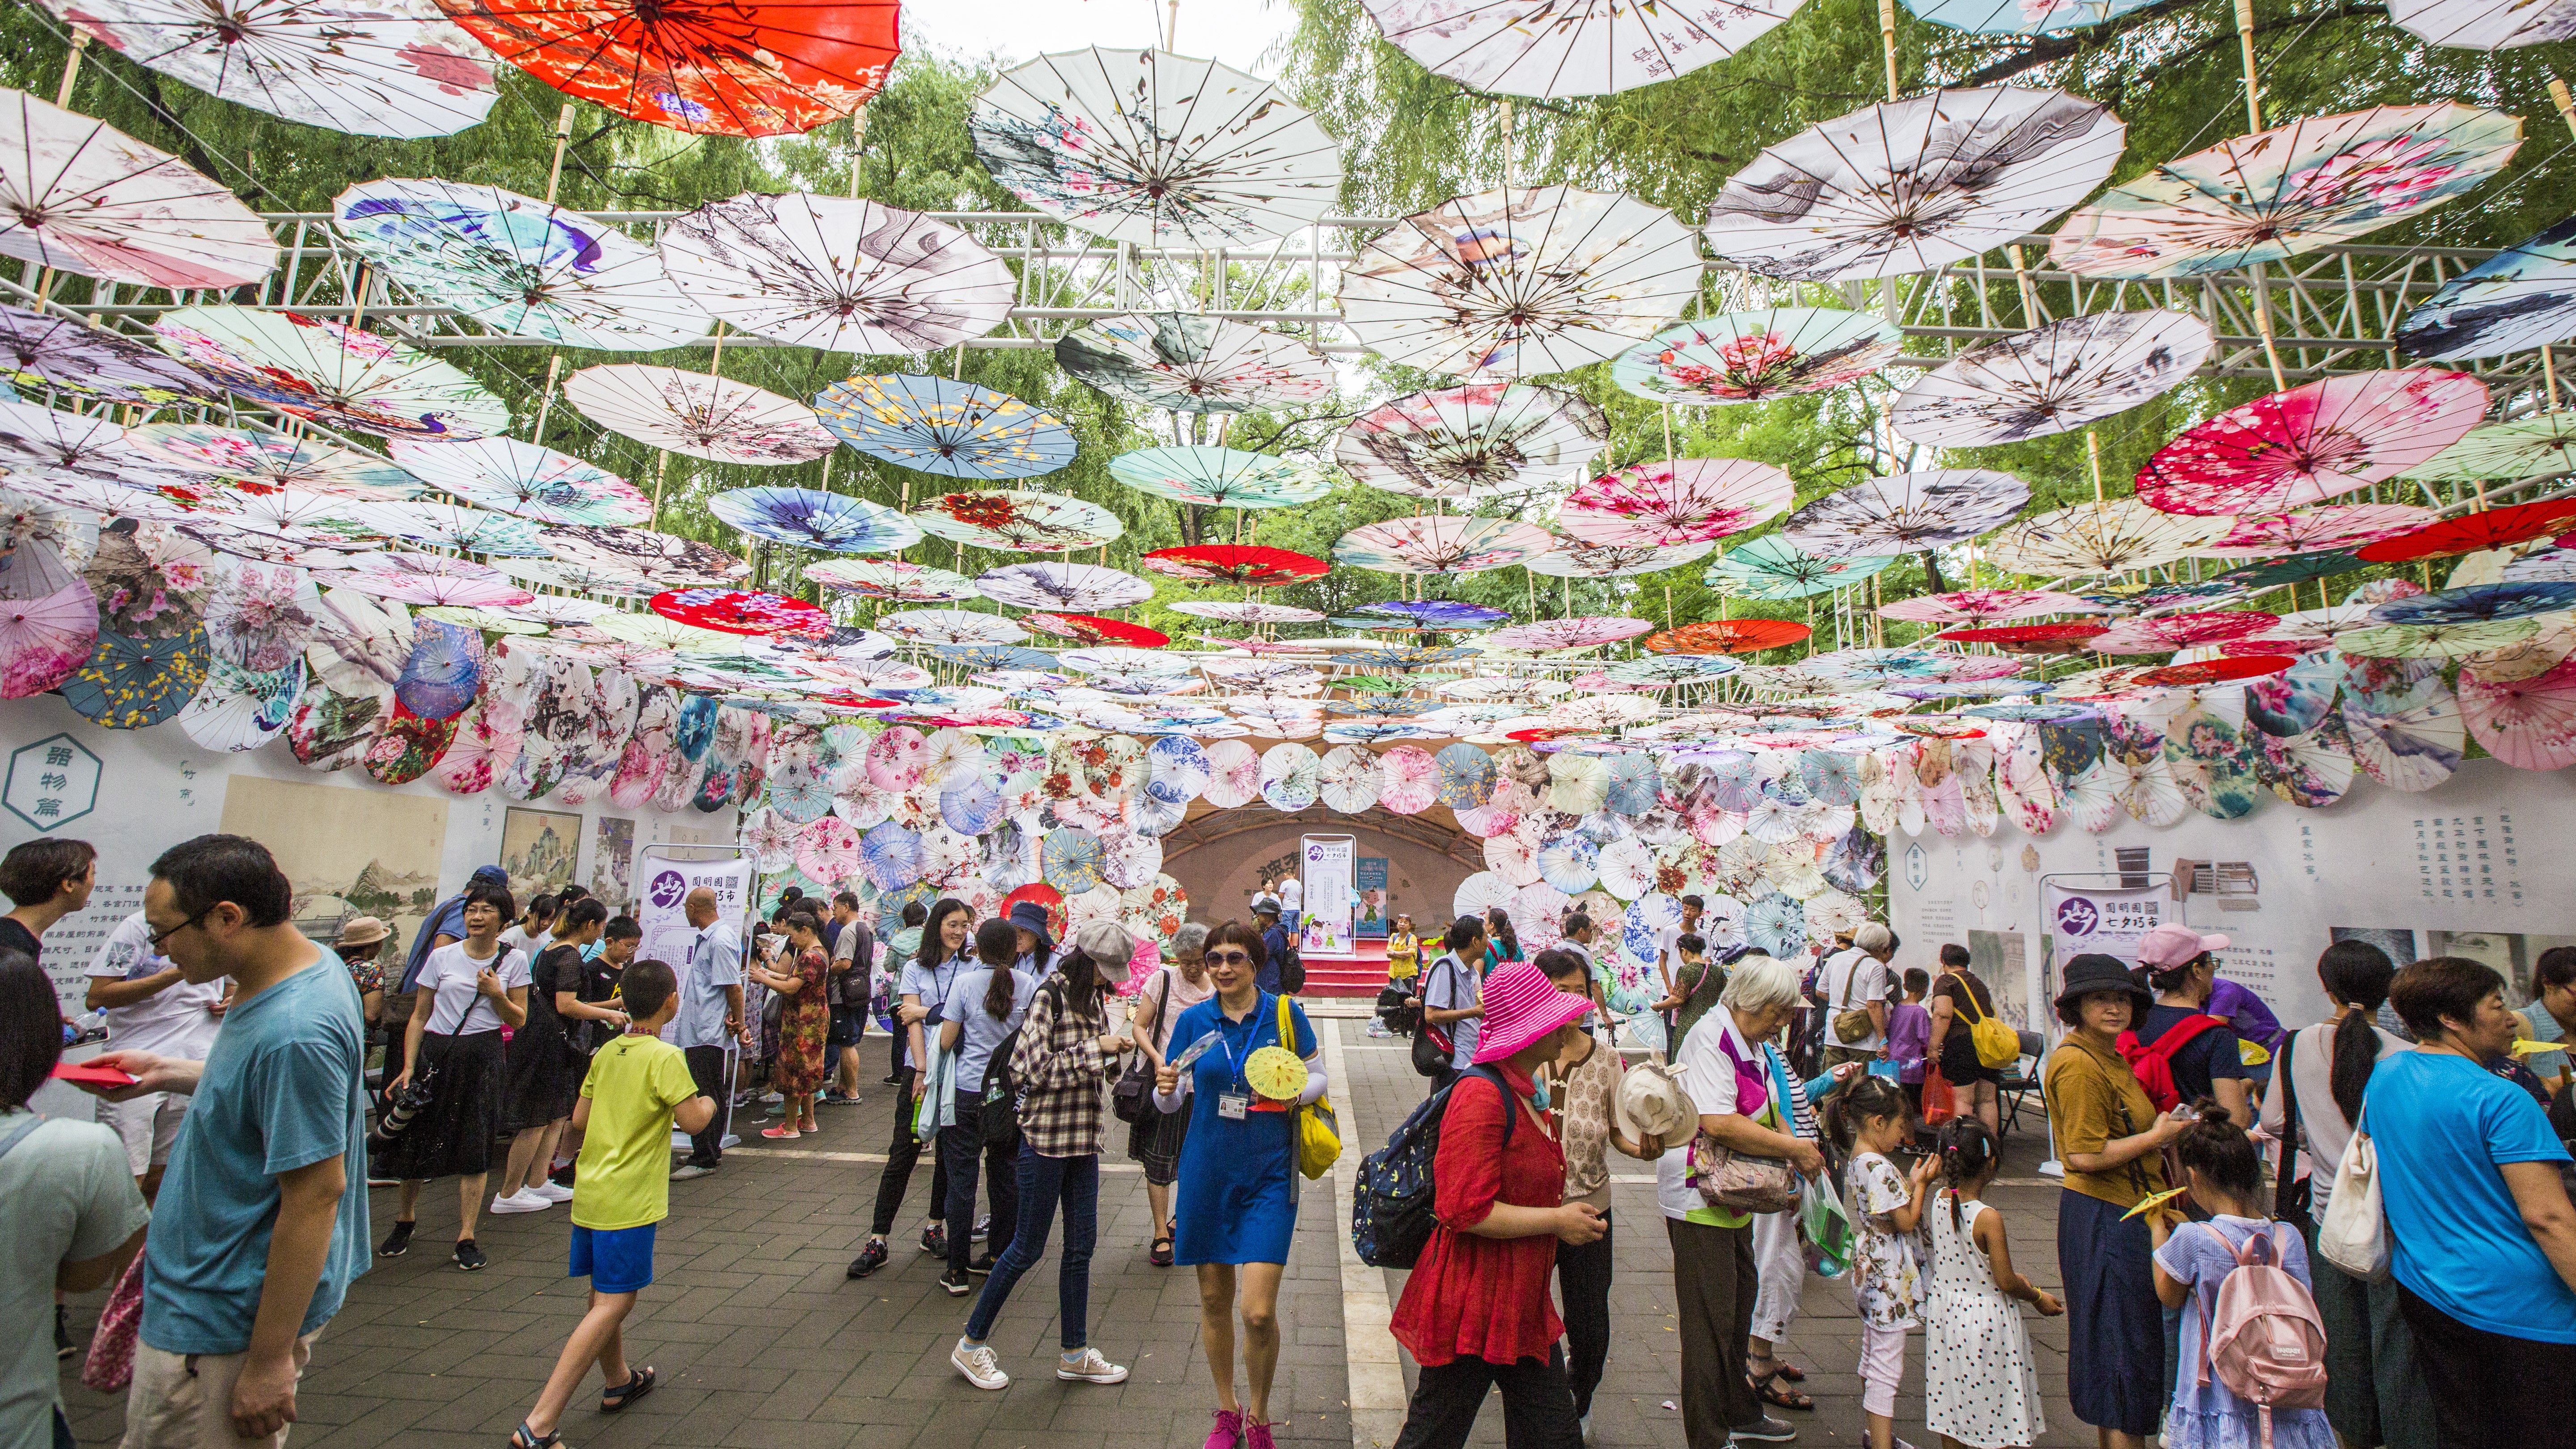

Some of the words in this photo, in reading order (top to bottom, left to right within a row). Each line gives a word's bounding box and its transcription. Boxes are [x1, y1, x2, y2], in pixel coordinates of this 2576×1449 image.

[34, 746, 73, 817] 器物篇
[2105, 916, 2158, 928] 七夕巧市
